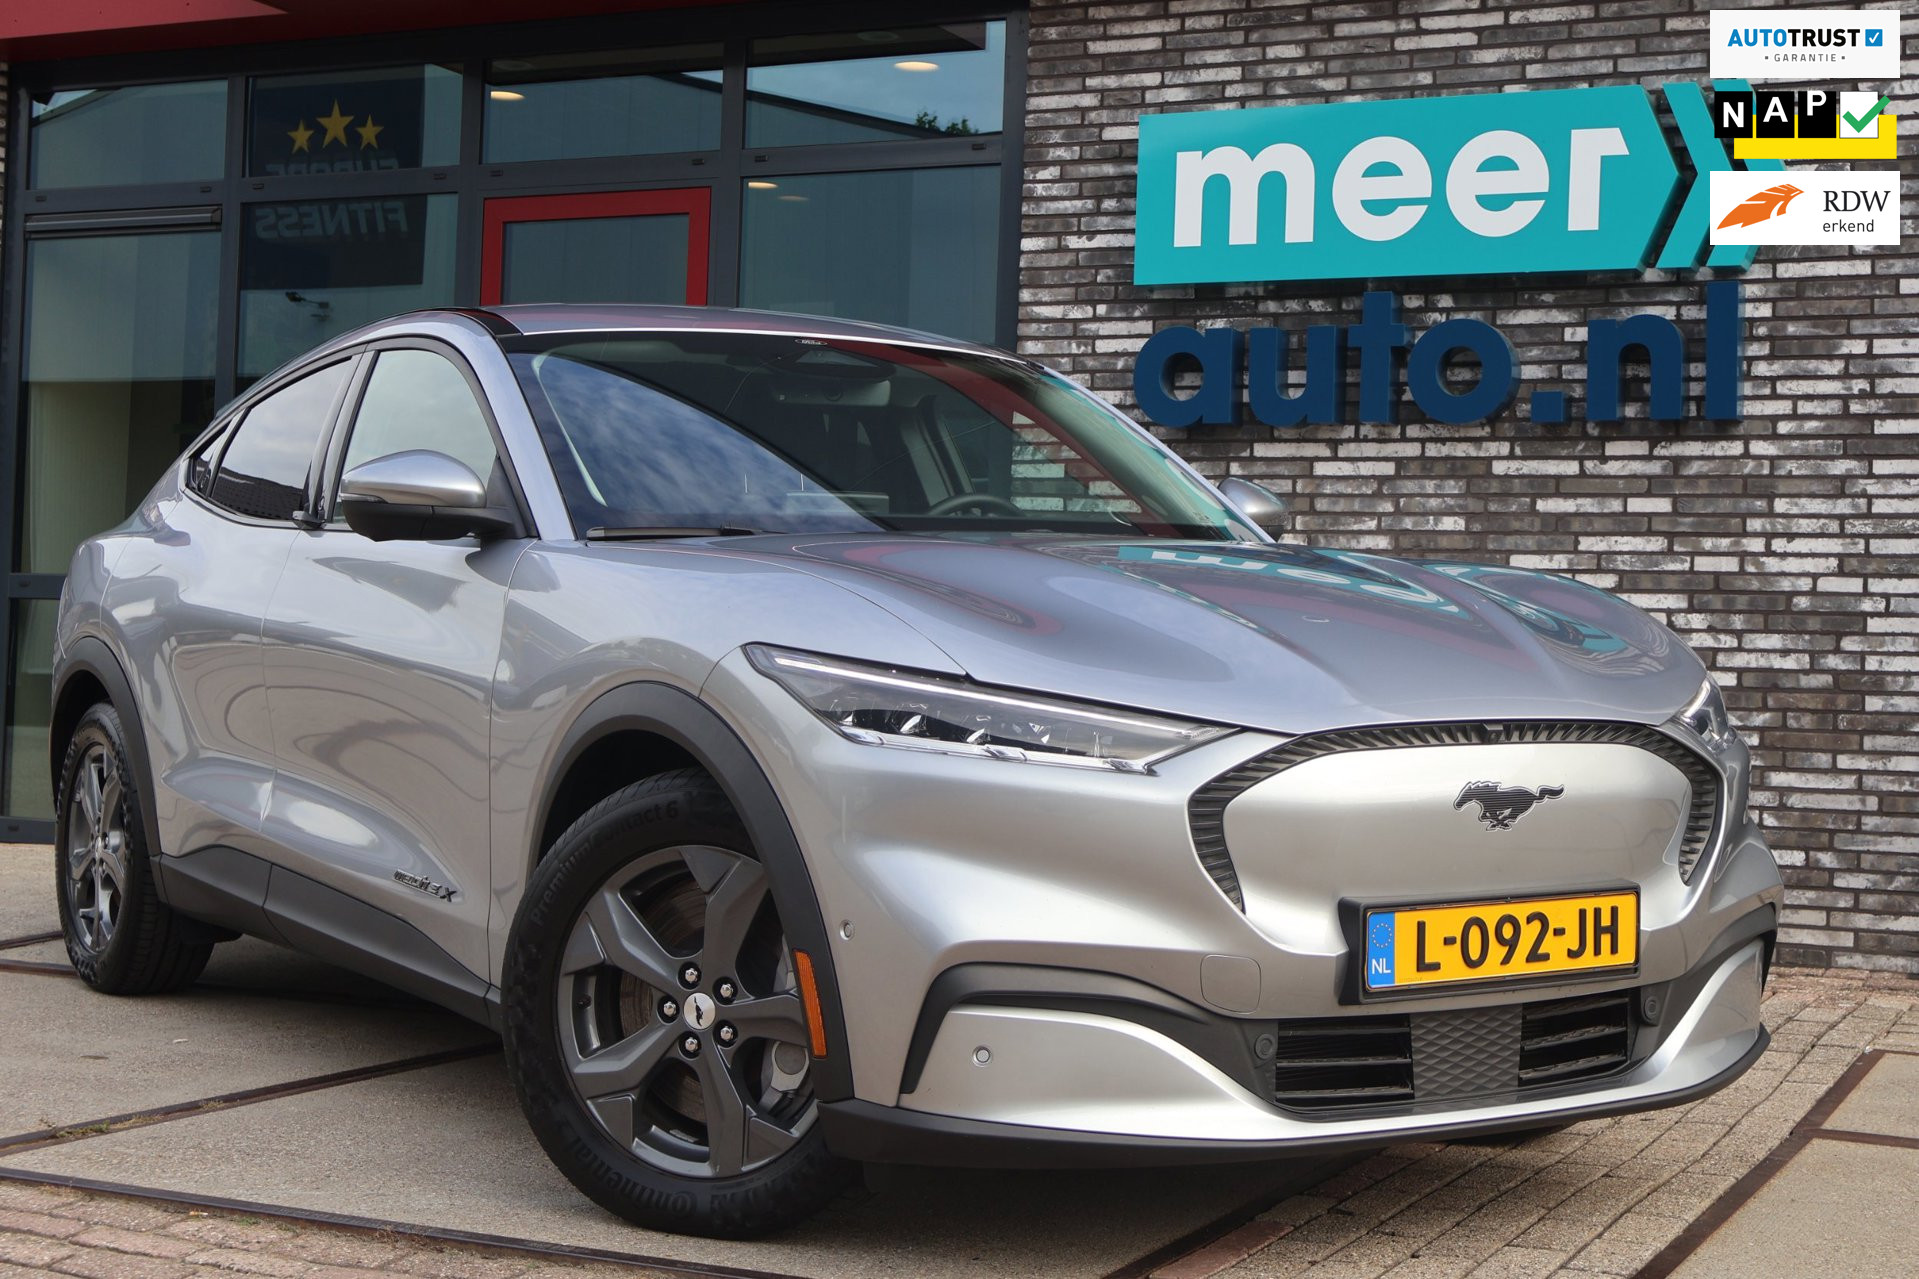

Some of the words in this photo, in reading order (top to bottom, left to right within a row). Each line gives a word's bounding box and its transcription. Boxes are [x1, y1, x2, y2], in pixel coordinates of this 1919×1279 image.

[1173, 127, 1630, 248] meer
[1133, 280, 1742, 427] auto.nl
[1371, 958, 1391, 974] NL
[1416, 905, 1619, 973] L-092-JH
